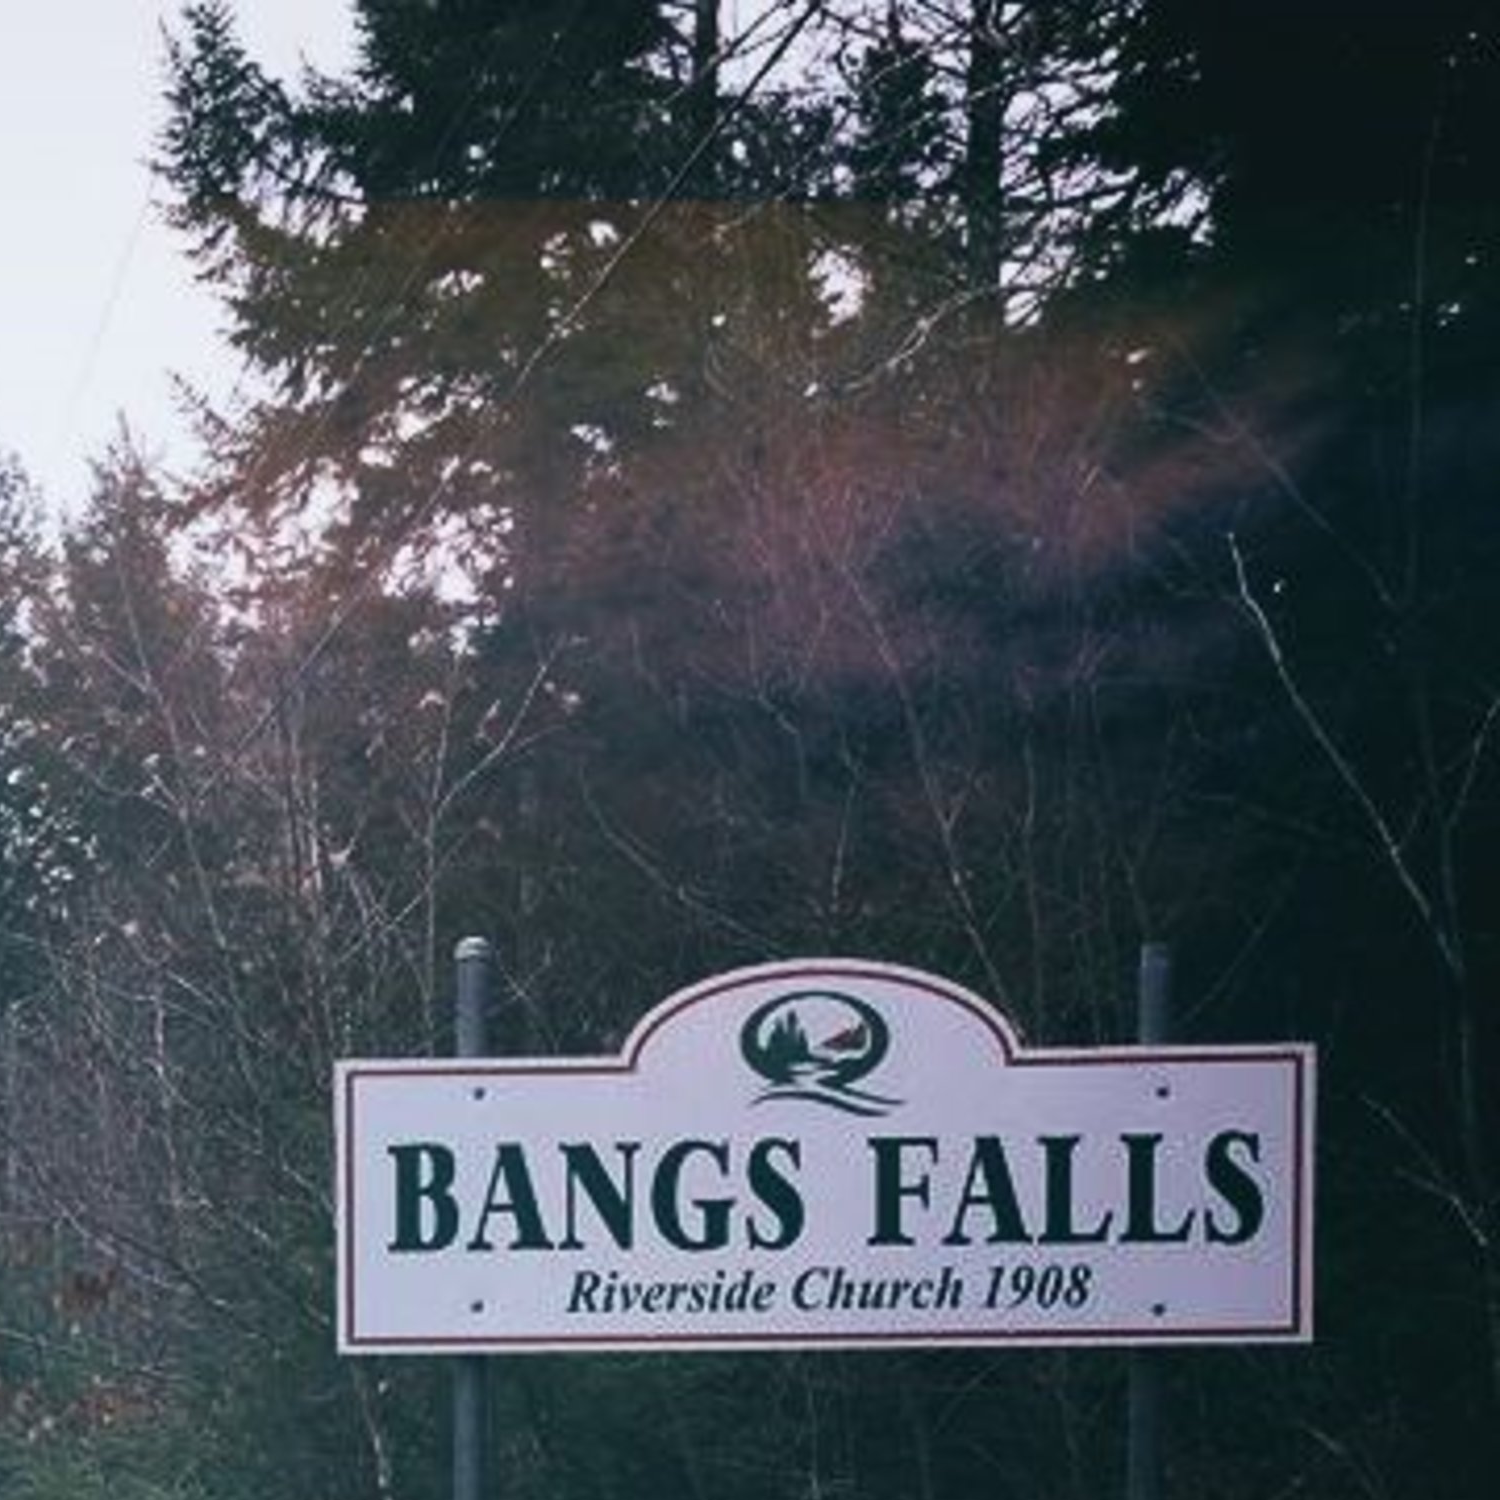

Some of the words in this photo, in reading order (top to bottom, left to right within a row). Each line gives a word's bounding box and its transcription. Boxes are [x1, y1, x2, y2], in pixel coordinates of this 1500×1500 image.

[386, 1137, 806, 1254] BANGS
[867, 1129, 1265, 1247] FALLS
[566, 1268, 776, 1315] Riverside
[791, 1265, 964, 1311] Church
[984, 1263, 1093, 1309] 1908
